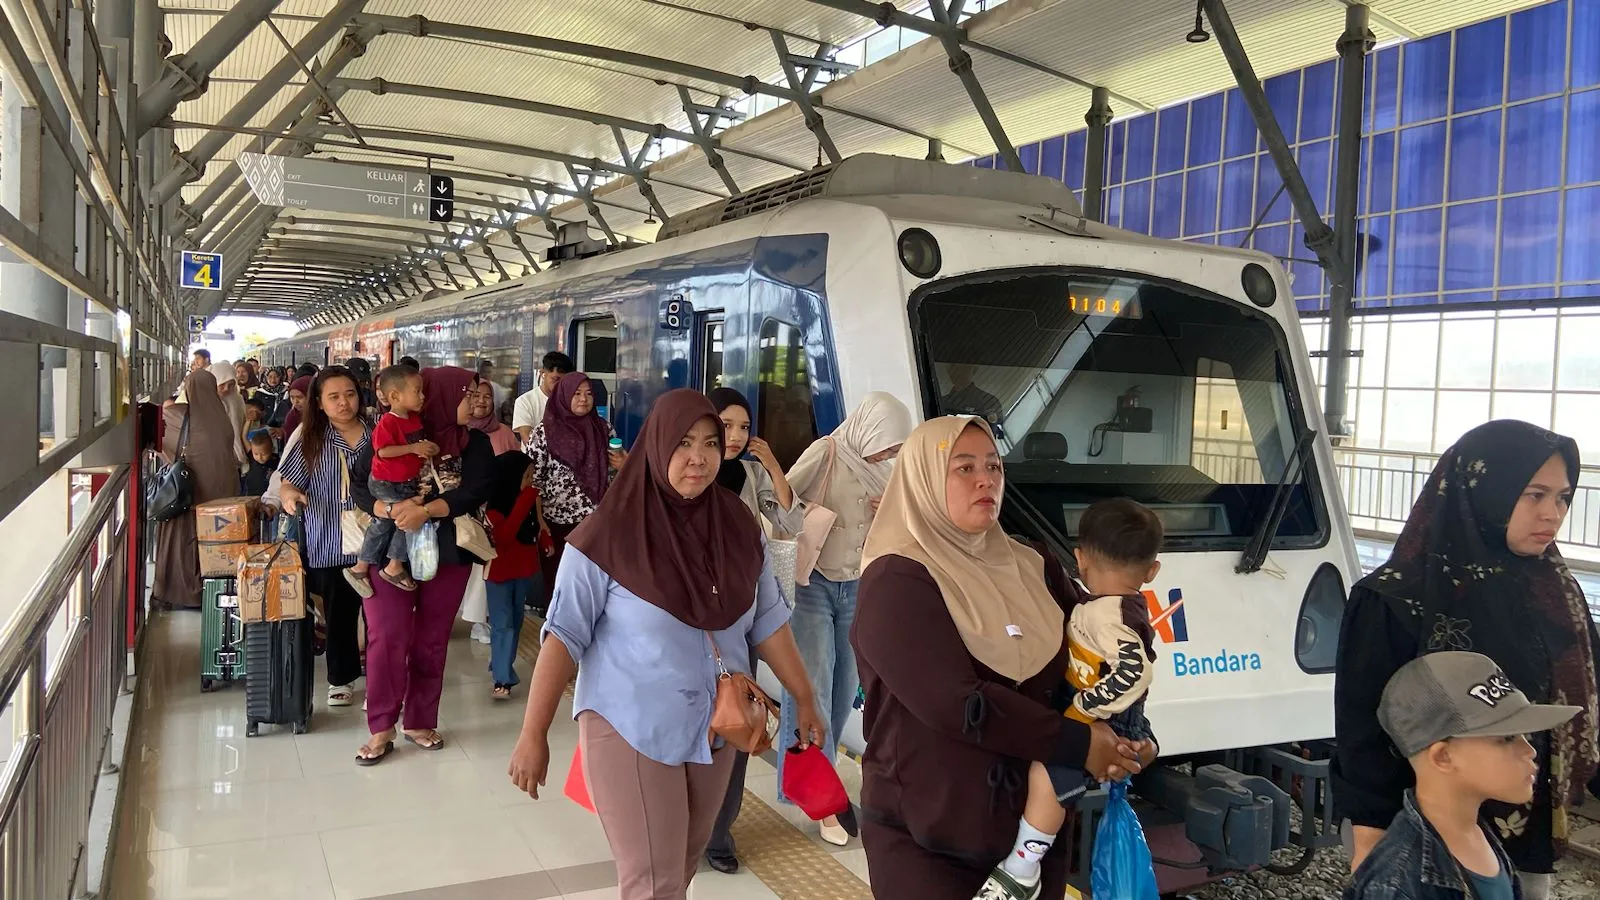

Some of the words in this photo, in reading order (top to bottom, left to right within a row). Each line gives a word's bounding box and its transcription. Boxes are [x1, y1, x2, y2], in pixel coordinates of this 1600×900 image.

[367, 170, 404, 182] KELUAR
[287, 198, 308, 206] TOILET
[367, 193, 400, 206] TOILET
[192, 254, 214, 262] Kereta
[194, 264, 213, 288] 4
[195, 319, 203, 331] 3
[1173, 648, 1262, 676] Bandara
